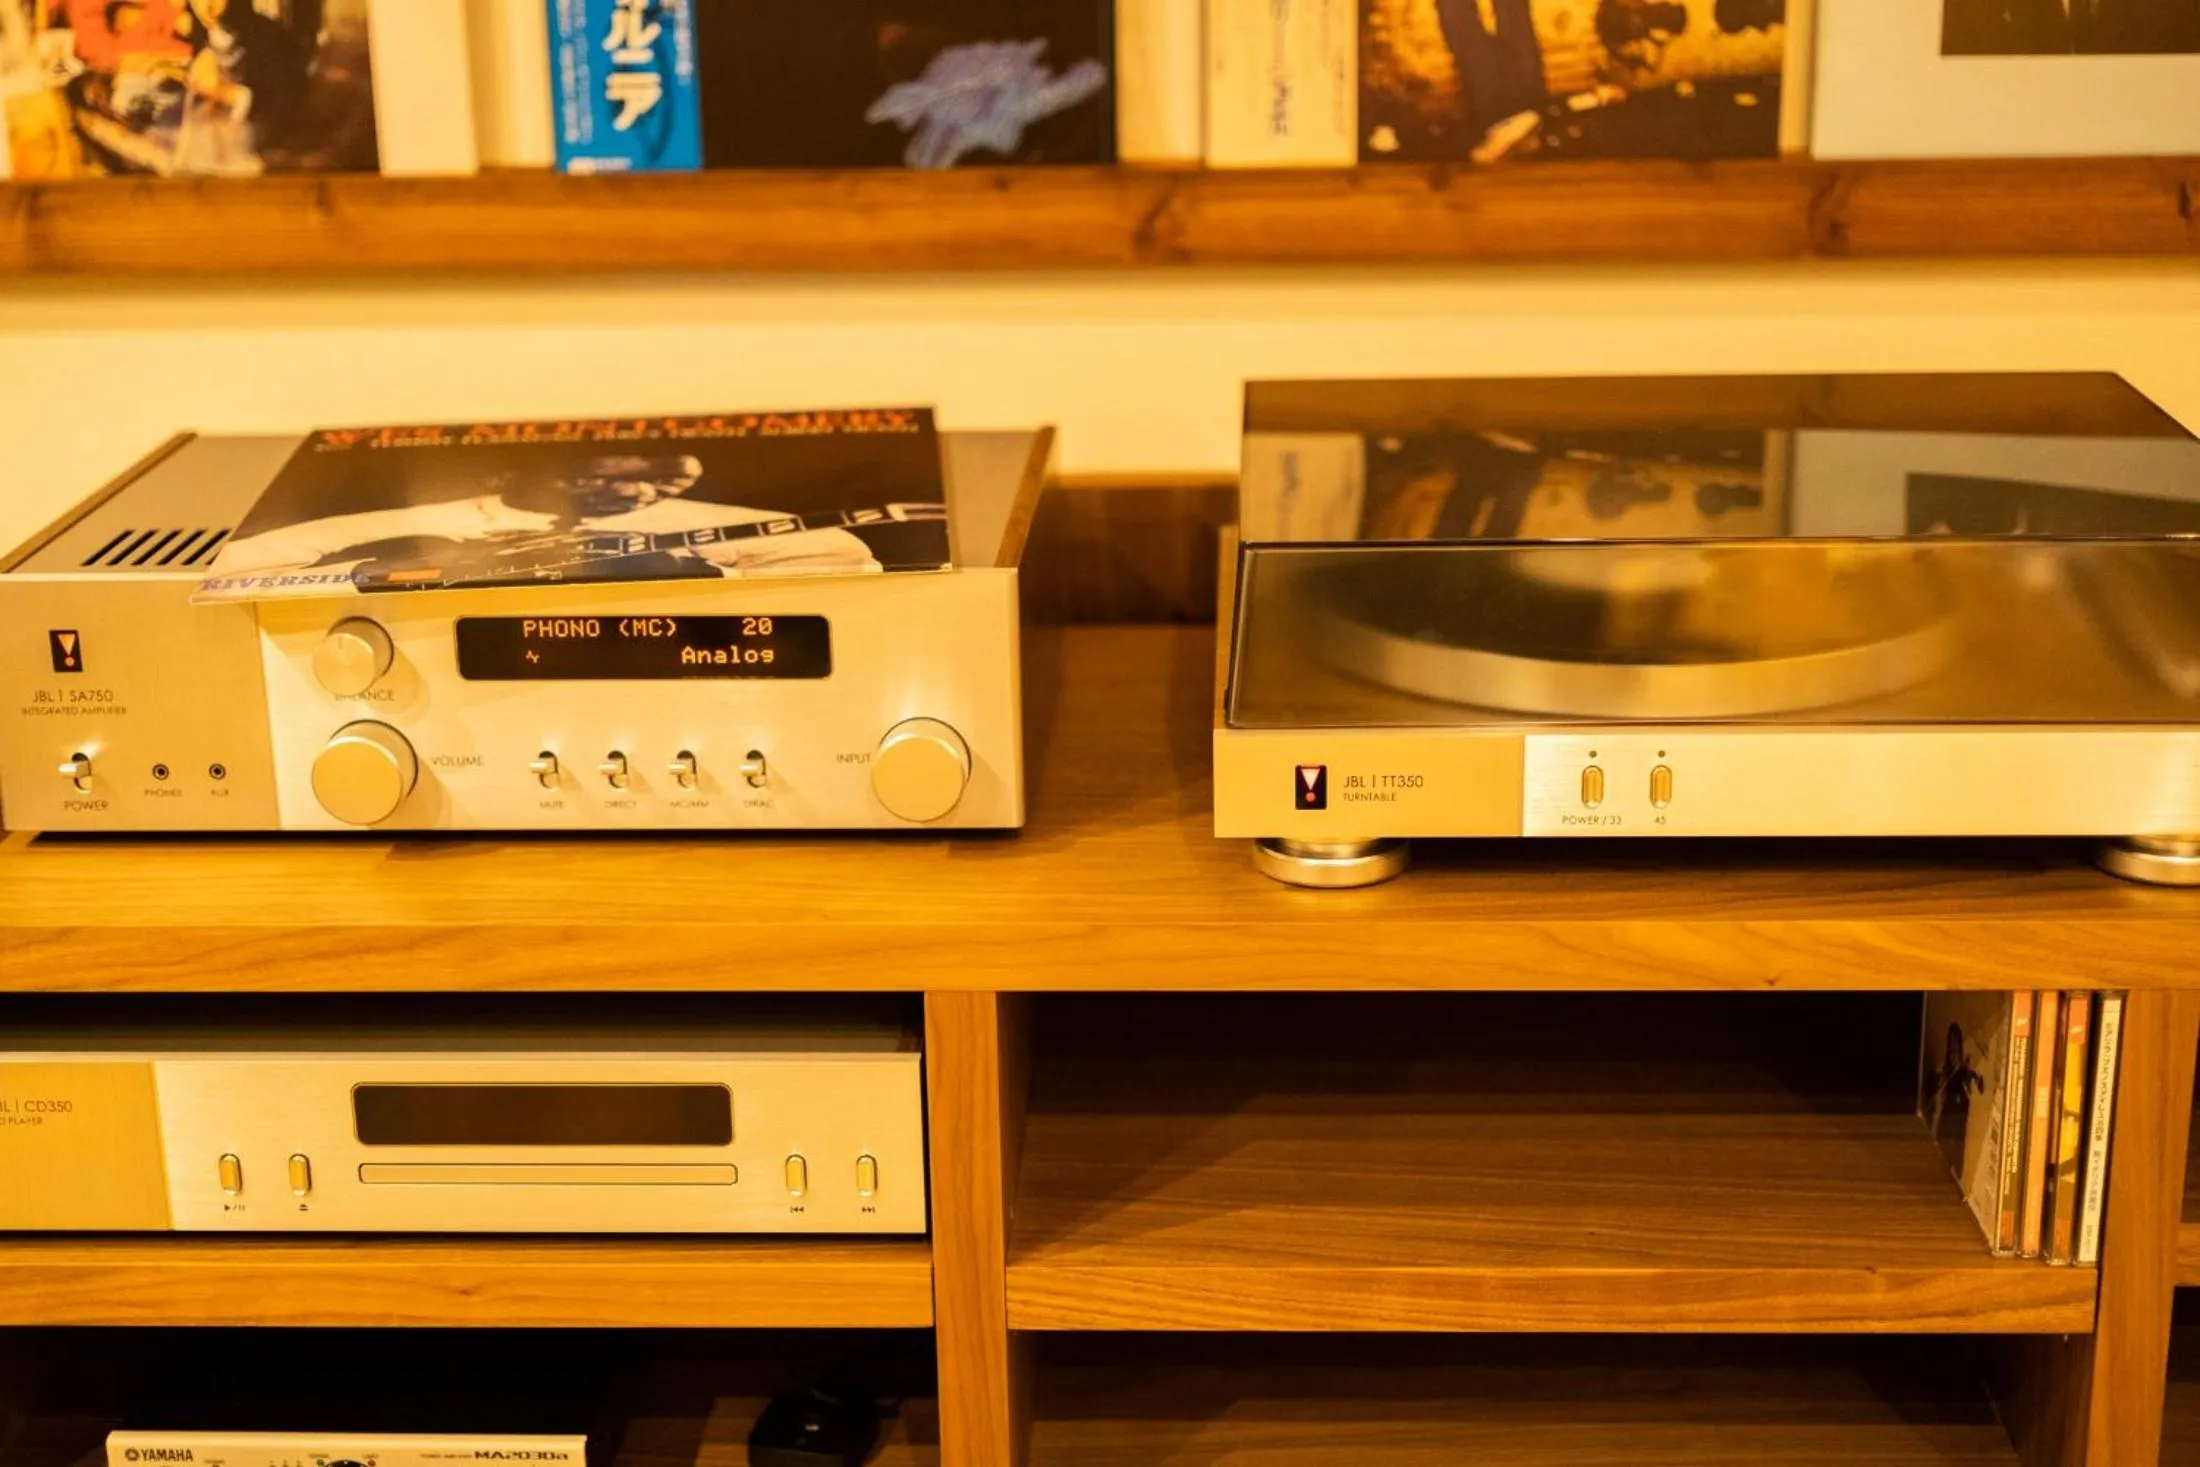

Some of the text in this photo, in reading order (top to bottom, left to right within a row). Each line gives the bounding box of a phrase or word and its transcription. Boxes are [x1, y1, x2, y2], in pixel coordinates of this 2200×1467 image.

[602, 0, 662, 131] ルニア
[202, 573, 371, 591] RIVERSIDE
[523, 617, 774, 639] PHONO (MC) 20
[681, 645, 775, 665] Analog
[32, 689, 55, 703] JBL
[69, 689, 115, 703] SA750
[431, 755, 484, 767] VOLUME
[836, 752, 872, 765] INPUT
[1343, 775, 1367, 788] JBL
[1381, 775, 1424, 788] TT350
[1343, 792, 1397, 802] TURNTABLE
[64, 800, 110, 812] POWER
[1562, 815, 1600, 825] POWER
[24, 1100, 73, 1113] CD350
[141, 1449, 194, 1462] YAMAHA
